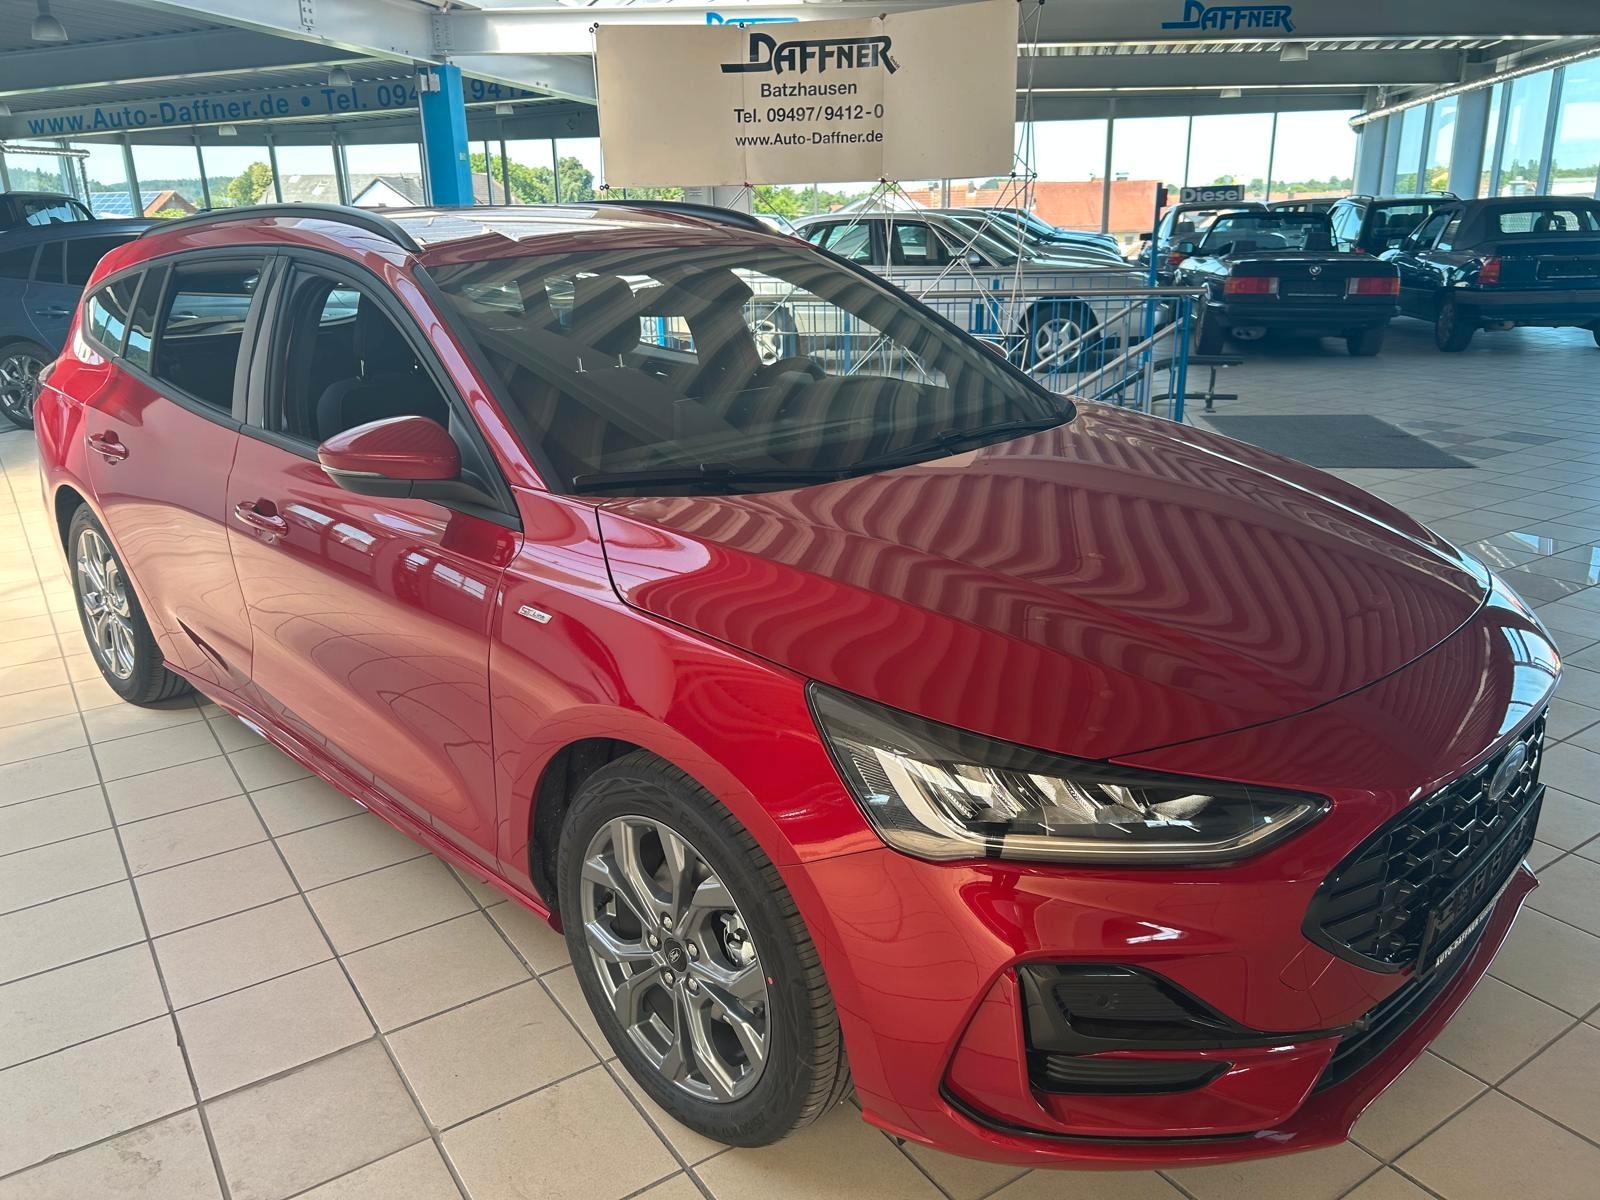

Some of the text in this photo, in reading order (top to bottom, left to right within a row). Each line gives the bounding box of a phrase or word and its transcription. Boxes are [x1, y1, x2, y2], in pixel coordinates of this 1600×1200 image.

[1161, 0, 1294, 33] DAFFNER
[720, 32, 896, 75] DAFFNER
[760, 82, 857, 98] Batzhausen
[28, 93, 289, 134] www.Auto-Daffner.de
[320, 88, 367, 111] Tel.
[734, 103, 884, 123] Tel. 09497/9412-0
[735, 130, 884, 146] www.Auto-Daffner.de
[1182, 184, 1243, 203] Diesel
